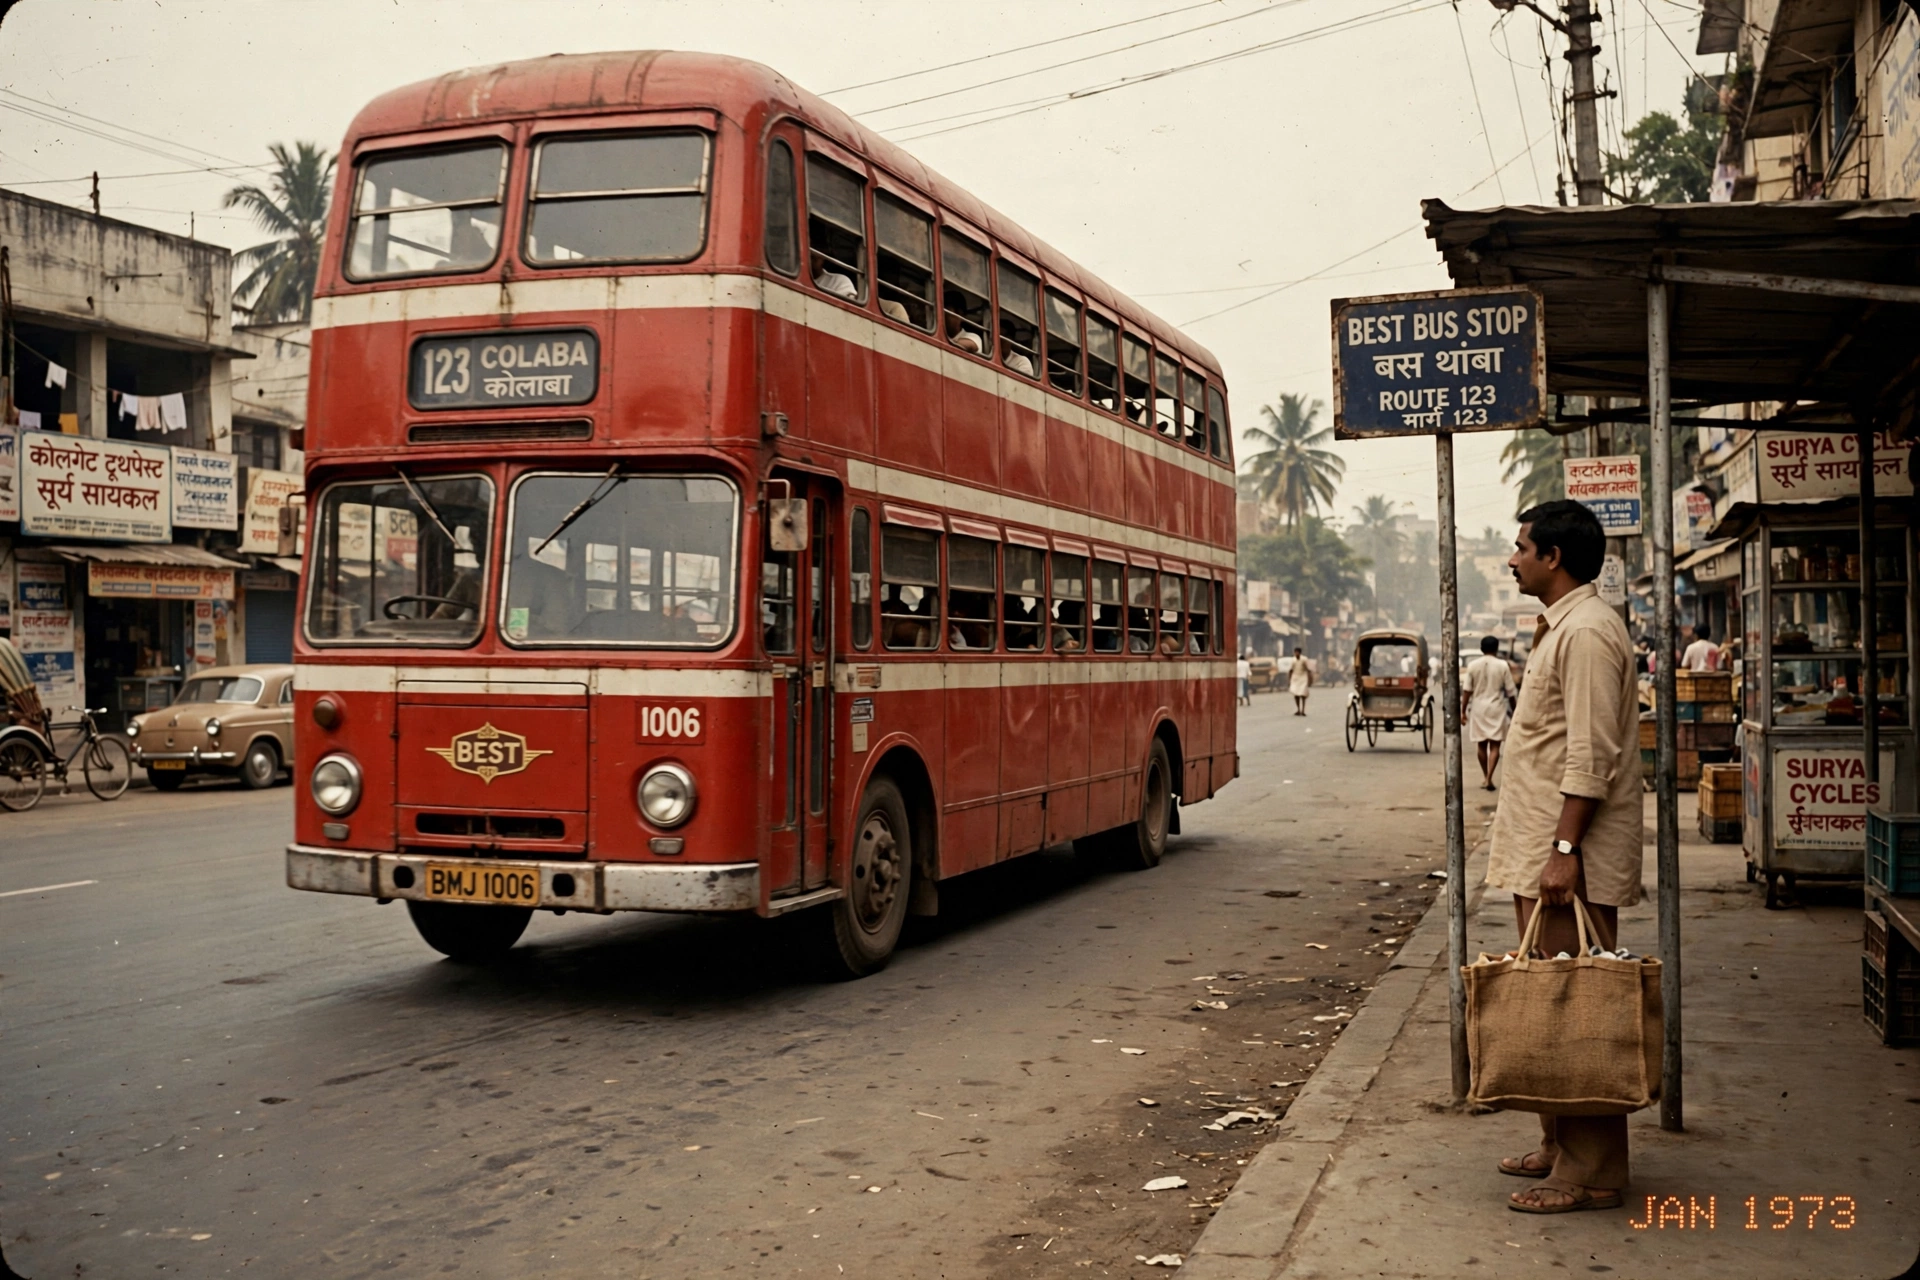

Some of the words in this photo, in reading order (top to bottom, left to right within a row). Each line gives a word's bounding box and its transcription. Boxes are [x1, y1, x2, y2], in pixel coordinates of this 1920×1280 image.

[1348, 314, 1405, 346] BEST
[1413, 310, 1459, 341] BUS
[1466, 305, 1528, 337] STOP
[423, 347, 471, 395] 123
[480, 340, 589, 369] COLABA
[1372, 352, 1424, 380] बस
[1435, 341, 1505, 376] थांबा
[483, 370, 573, 398] कोलाबा
[1379, 387, 1450, 412] ROUTE
[1460, 385, 1497, 406] 123
[1453, 408, 1488, 426] 123
[29, 439, 99, 472] कोलगेट
[105, 450, 164, 482] टूथपेस्ट
[1766, 437, 1835, 458] SURYA
[1770, 456, 1808, 488] सूर्य
[37, 472, 74, 510] सूर्य
[81, 483, 160, 511] सायकल
[641, 706, 700, 738] 1006
[457, 741, 521, 764] BEST
[1786, 758, 1866, 779] SURYA
[1790, 783, 1880, 804] CYCLES
[431, 870, 476, 896] BMJ
[484, 873, 535, 899] 1006
